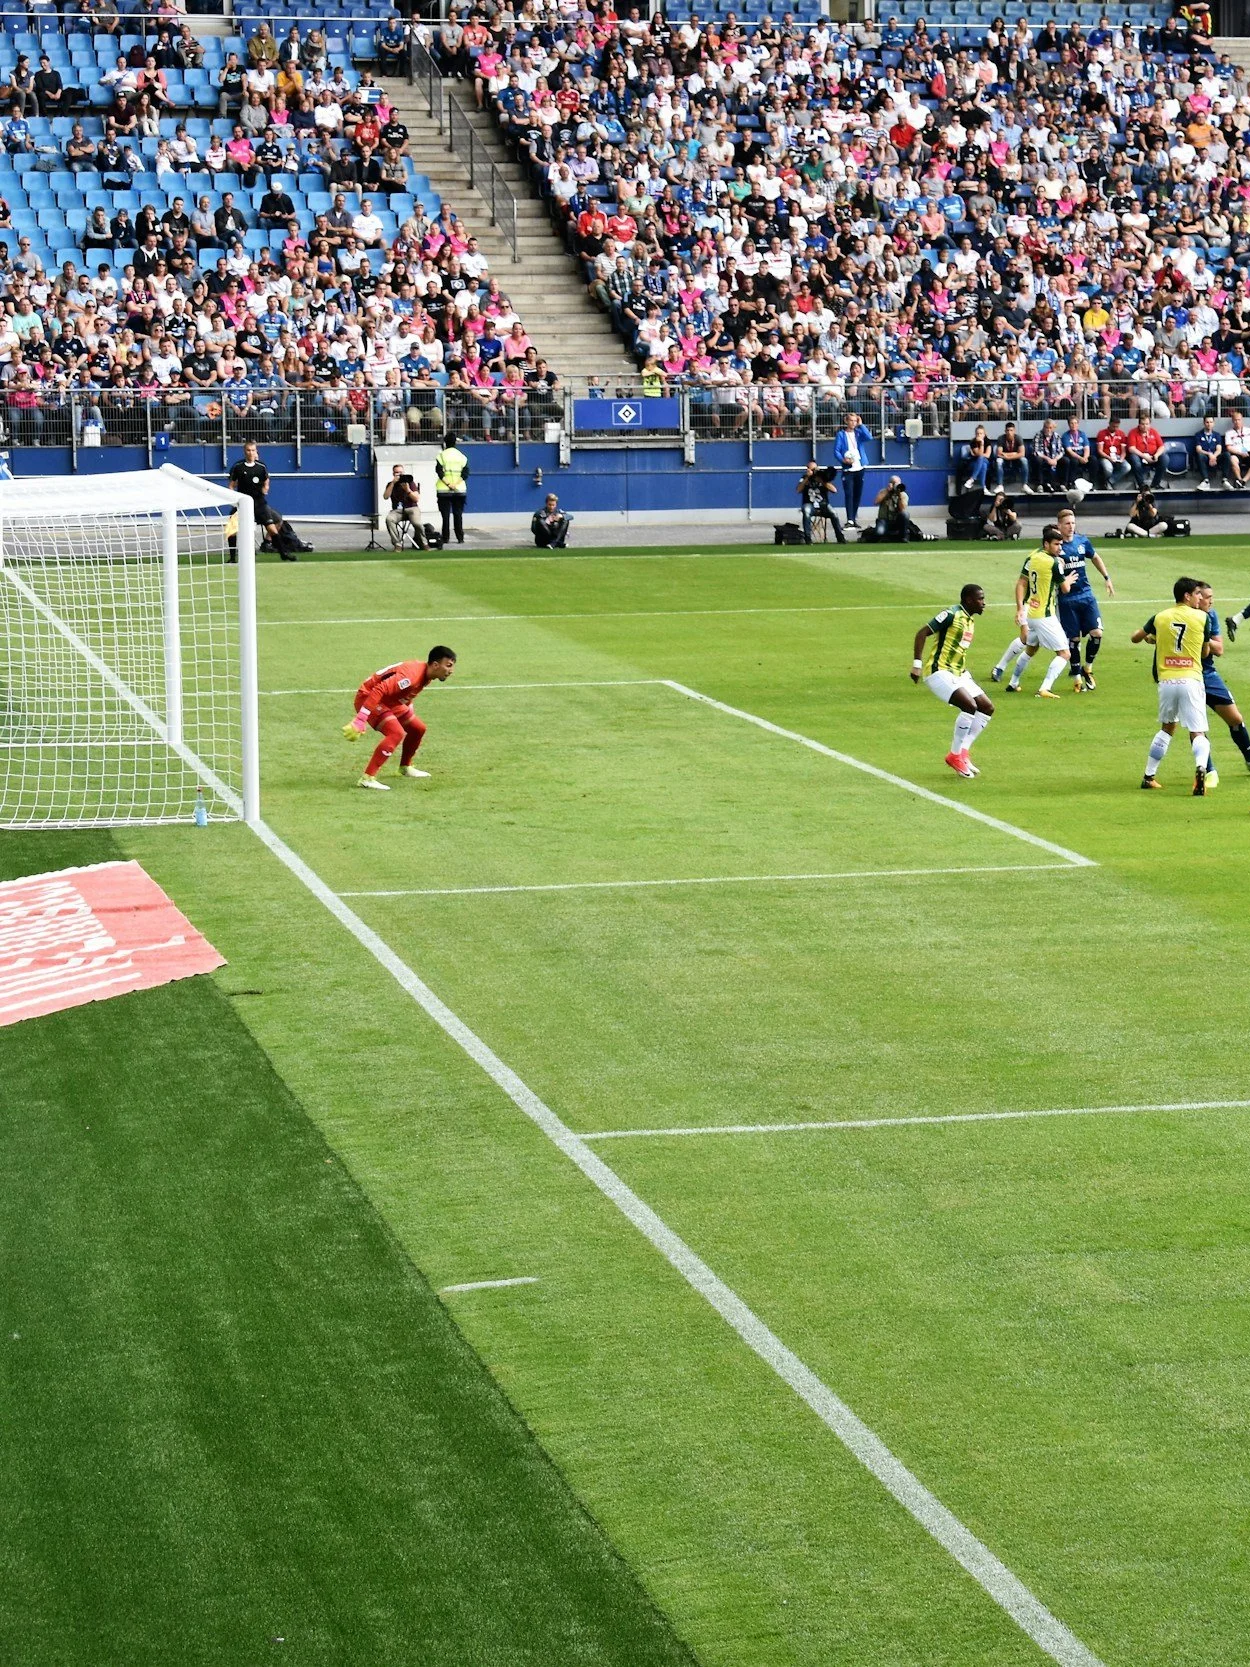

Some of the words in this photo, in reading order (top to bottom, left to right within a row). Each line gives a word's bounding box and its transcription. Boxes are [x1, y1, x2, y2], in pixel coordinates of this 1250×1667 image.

[160, 436, 166, 445] 1
[1030, 570, 1038, 594] 3
[1171, 622, 1188, 653] 7
